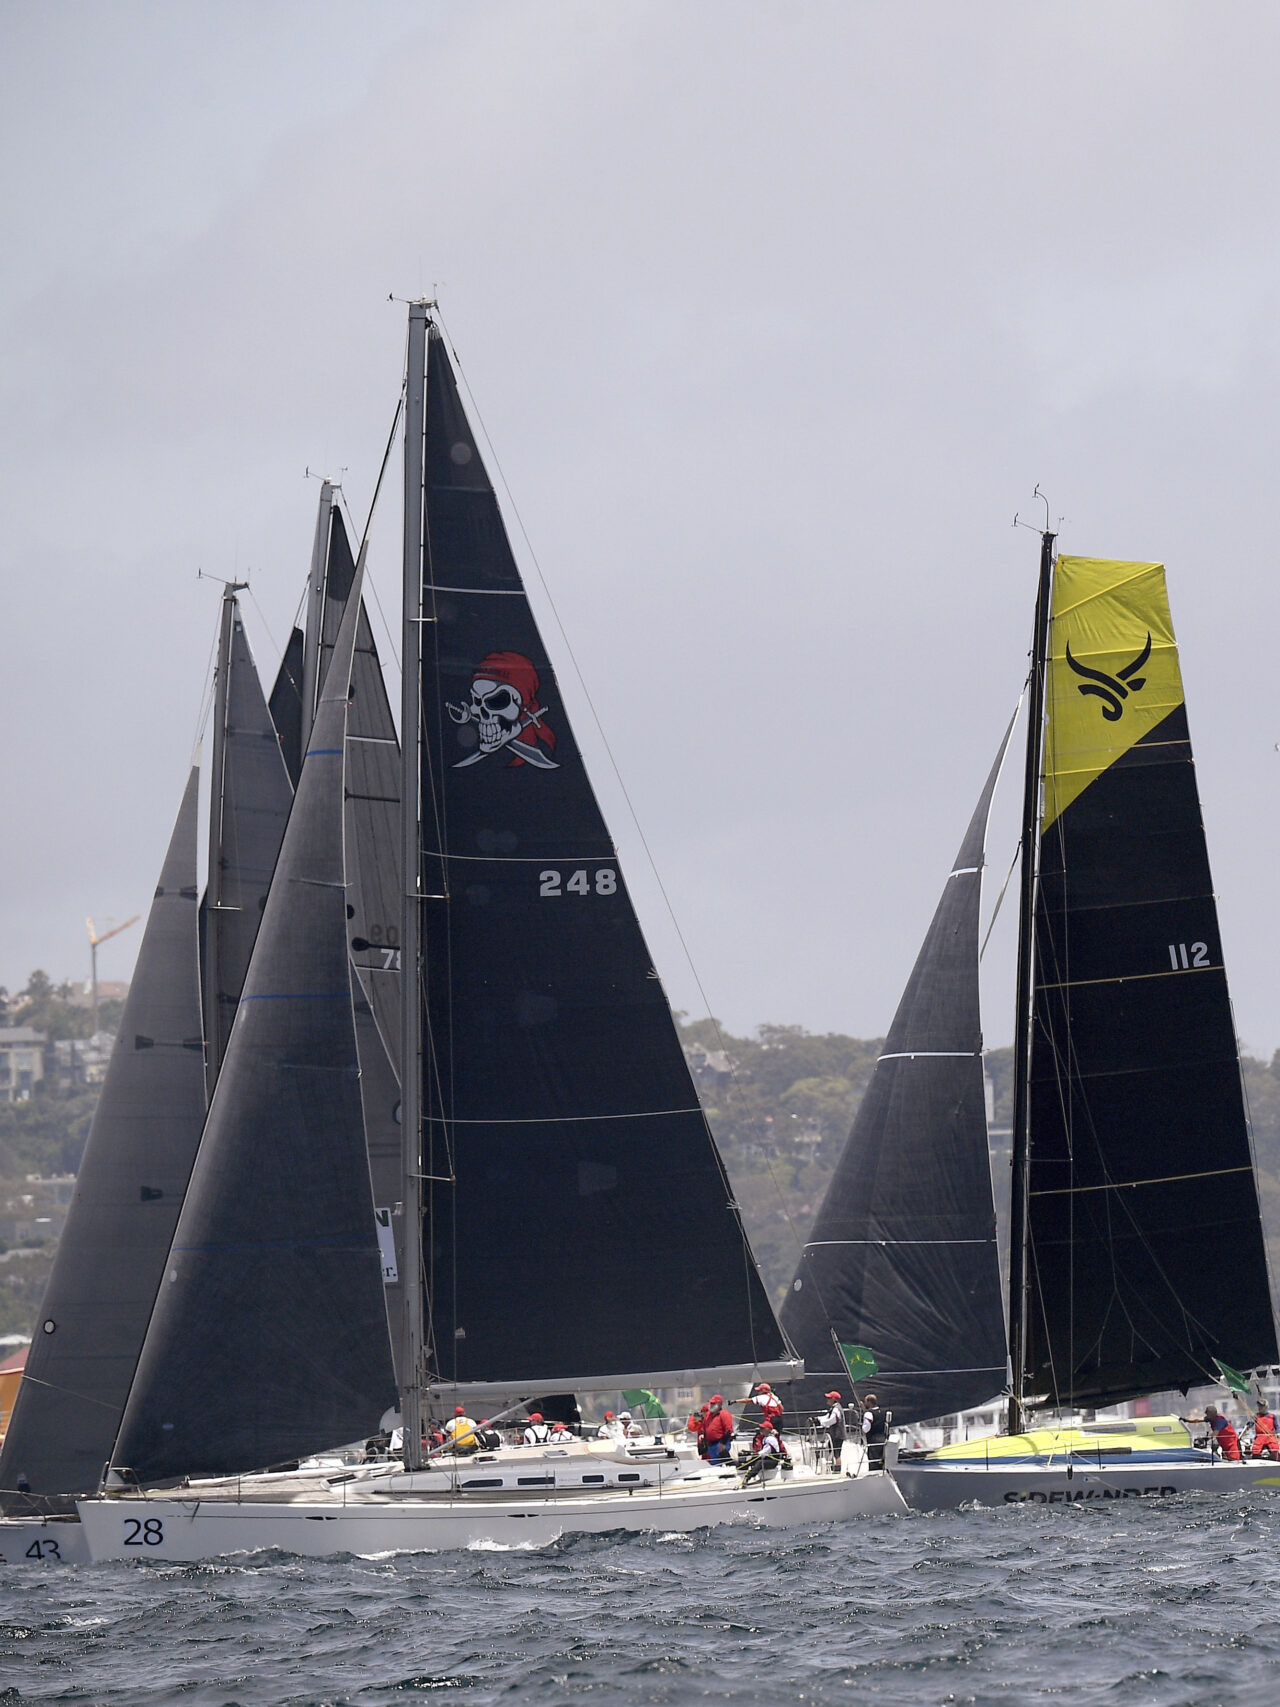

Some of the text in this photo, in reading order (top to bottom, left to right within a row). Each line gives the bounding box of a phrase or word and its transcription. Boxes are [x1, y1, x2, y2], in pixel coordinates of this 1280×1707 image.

[539, 868, 617, 897] 248
[1168, 941, 1211, 970] 112
[123, 1518, 164, 1546] 28
[25, 1540, 61, 1560] 43
